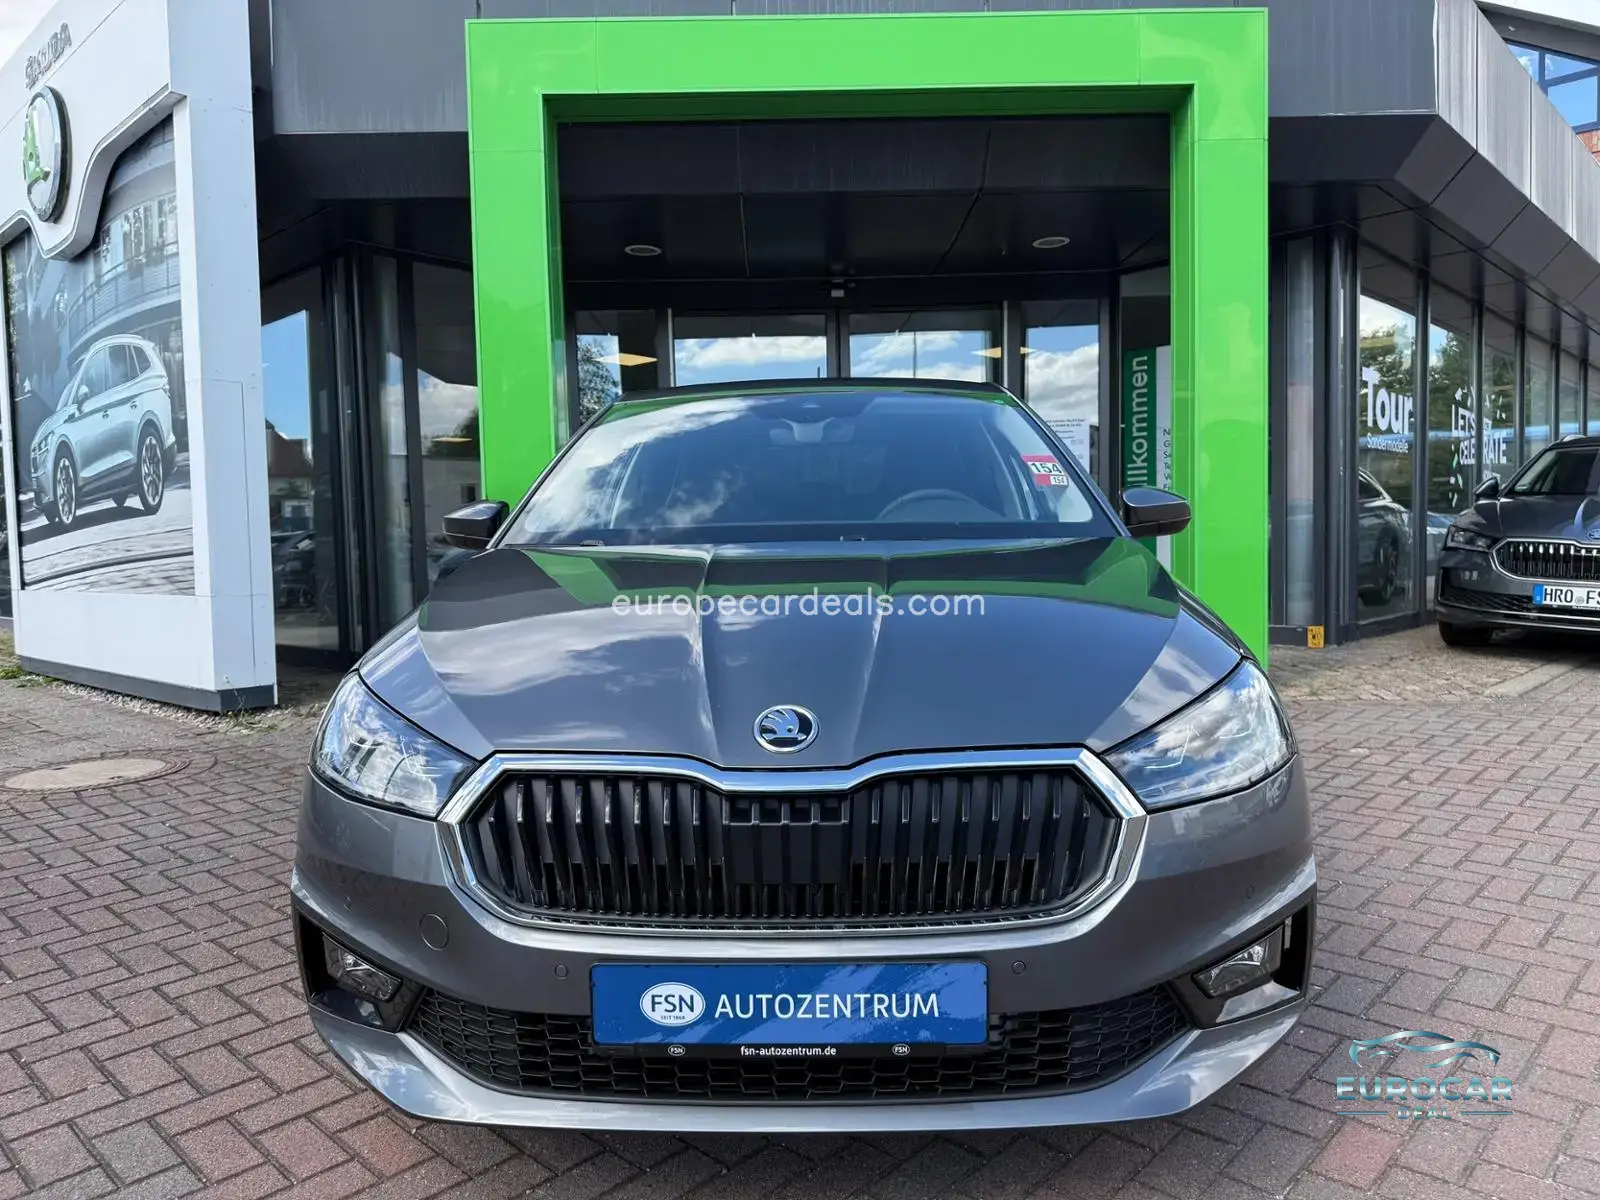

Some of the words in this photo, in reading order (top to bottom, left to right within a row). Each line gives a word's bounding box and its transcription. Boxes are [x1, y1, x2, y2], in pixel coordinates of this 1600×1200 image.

[1127, 355, 1148, 487] illkommen
[1031, 462, 1062, 474] 154
[1544, 587, 1574, 603] HRO
[651, 994, 695, 1013] FSN
[715, 992, 940, 1019] AUTOZENTRUM
[740, 1045, 837, 1057] fsn-autozentrum.de
